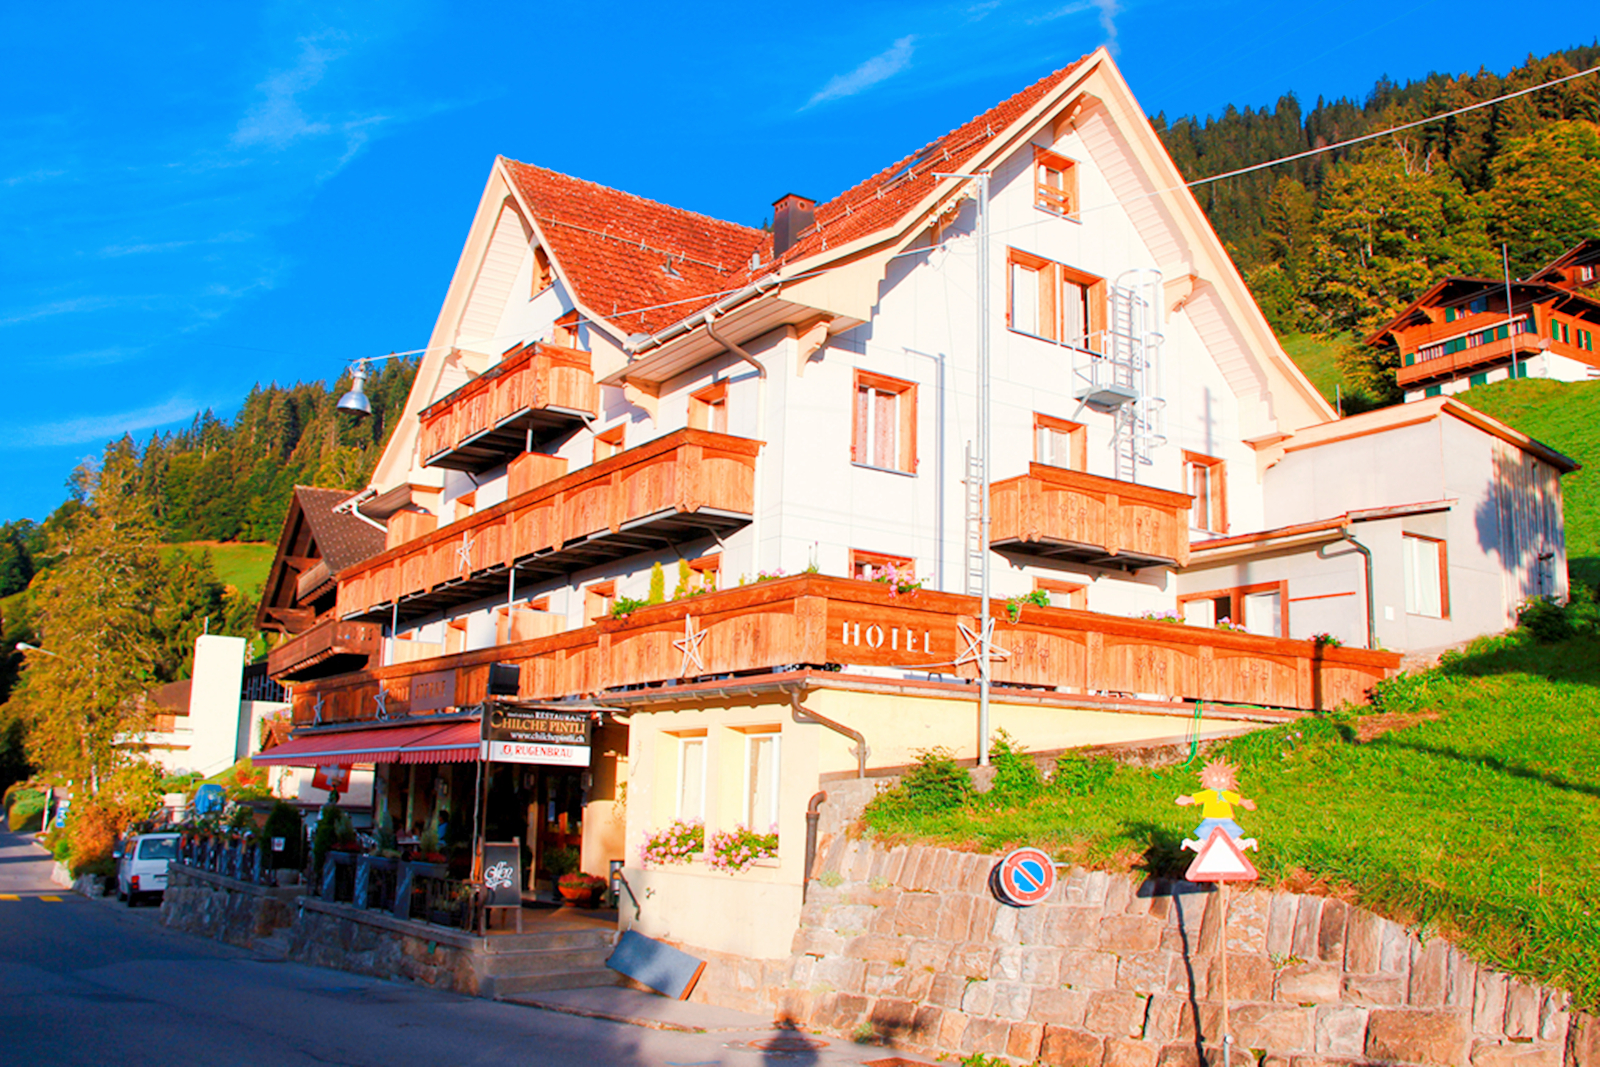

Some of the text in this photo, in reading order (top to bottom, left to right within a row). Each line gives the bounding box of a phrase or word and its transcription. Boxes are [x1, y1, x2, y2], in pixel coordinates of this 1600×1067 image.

[843, 622, 934, 654] HOTEL
[491, 711, 547, 730] CHILCHE
[549, 720, 586, 734] PINTLI
[535, 711, 587, 722] RESTAURANT
[510, 731, 585, 744] www.chilchepintli.ch
